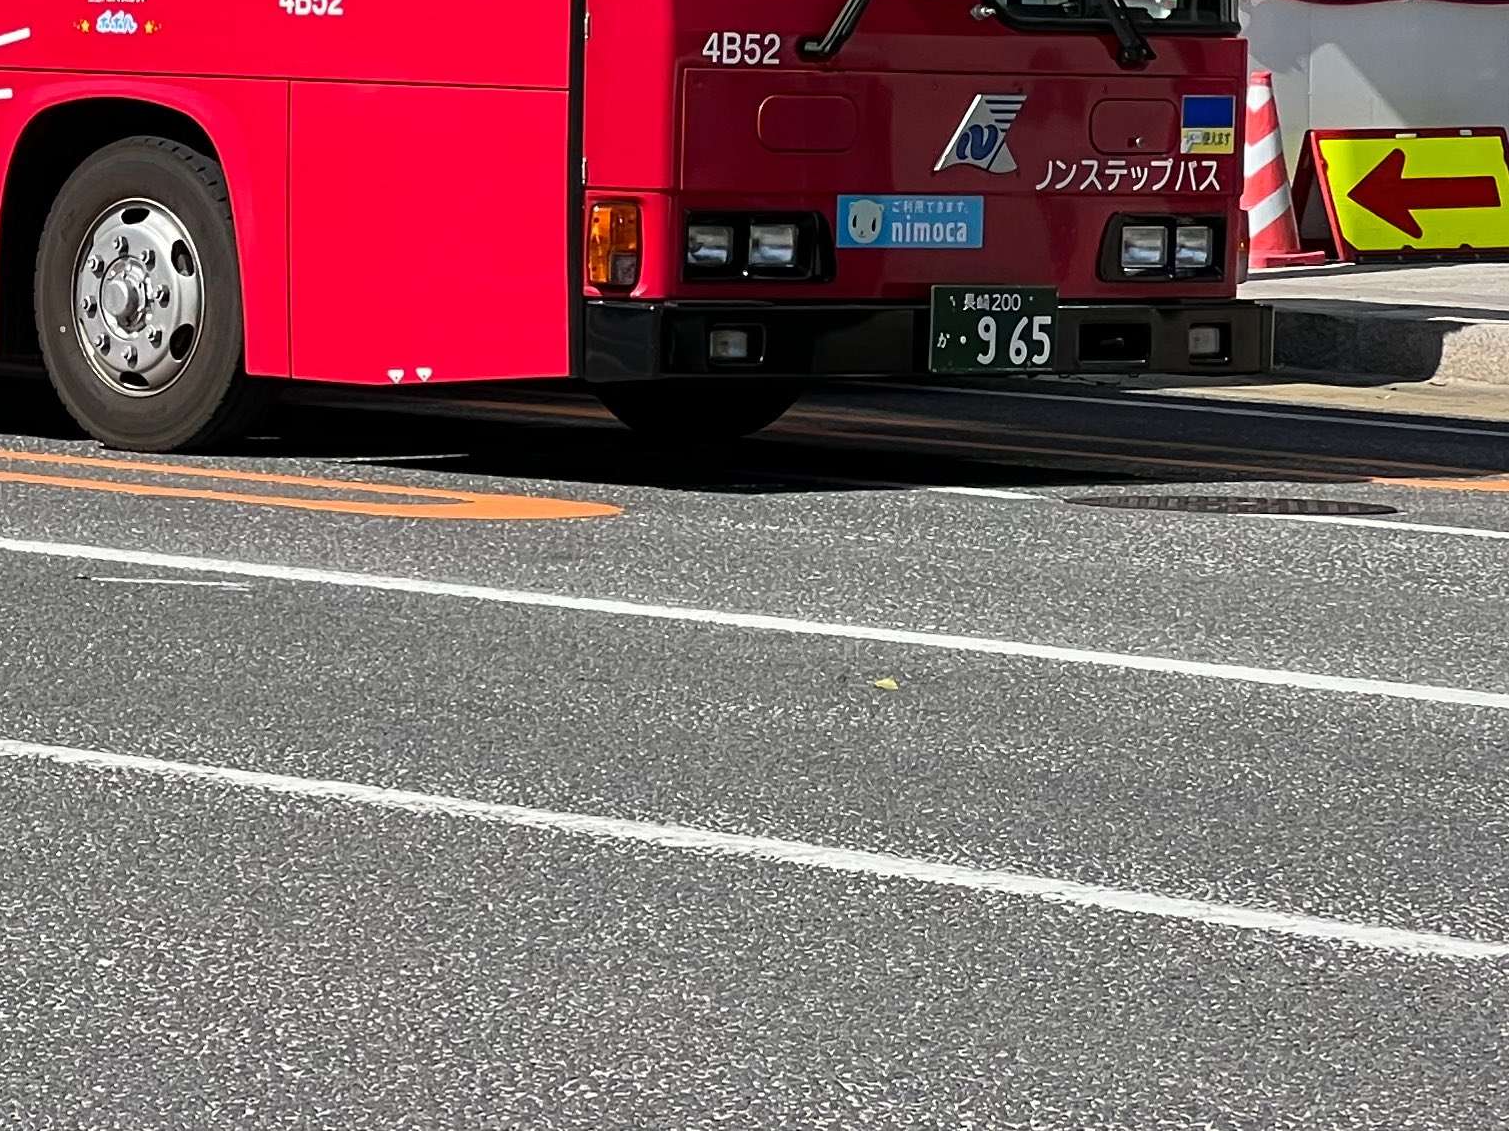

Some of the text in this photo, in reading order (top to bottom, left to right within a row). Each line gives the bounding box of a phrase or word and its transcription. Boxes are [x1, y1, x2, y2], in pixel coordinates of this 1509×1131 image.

[702, 31, 782, 66] 4B52
[1035, 157, 1222, 192] ノンステップバス
[892, 214, 968, 243] nimoca
